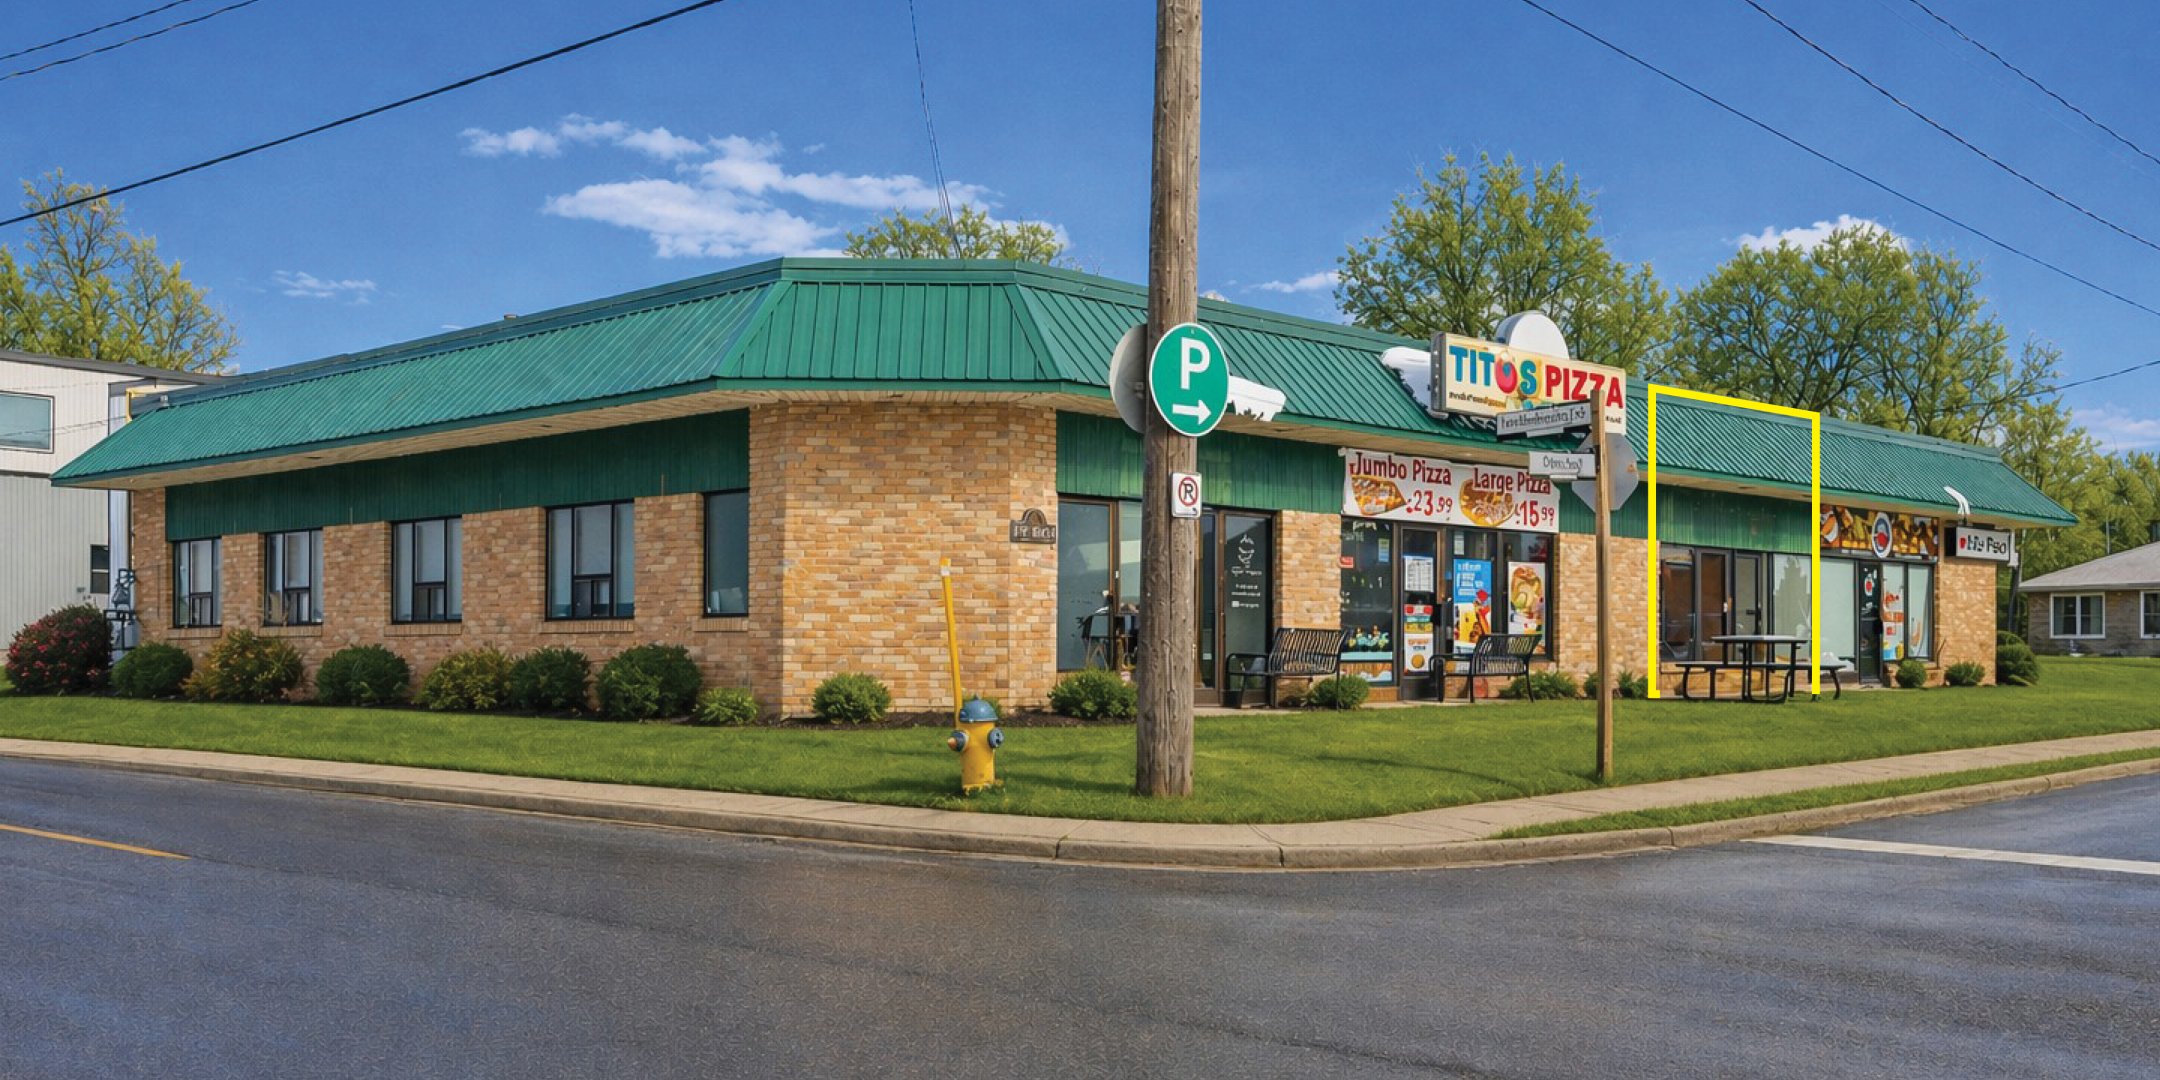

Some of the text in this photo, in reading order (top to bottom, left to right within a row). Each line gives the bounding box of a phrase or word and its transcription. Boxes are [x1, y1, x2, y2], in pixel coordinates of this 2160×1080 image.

[1180, 336, 1211, 390] P
[1355, 452, 1452, 485] Jumbo Pizza
[1474, 467, 1513, 496] Large
